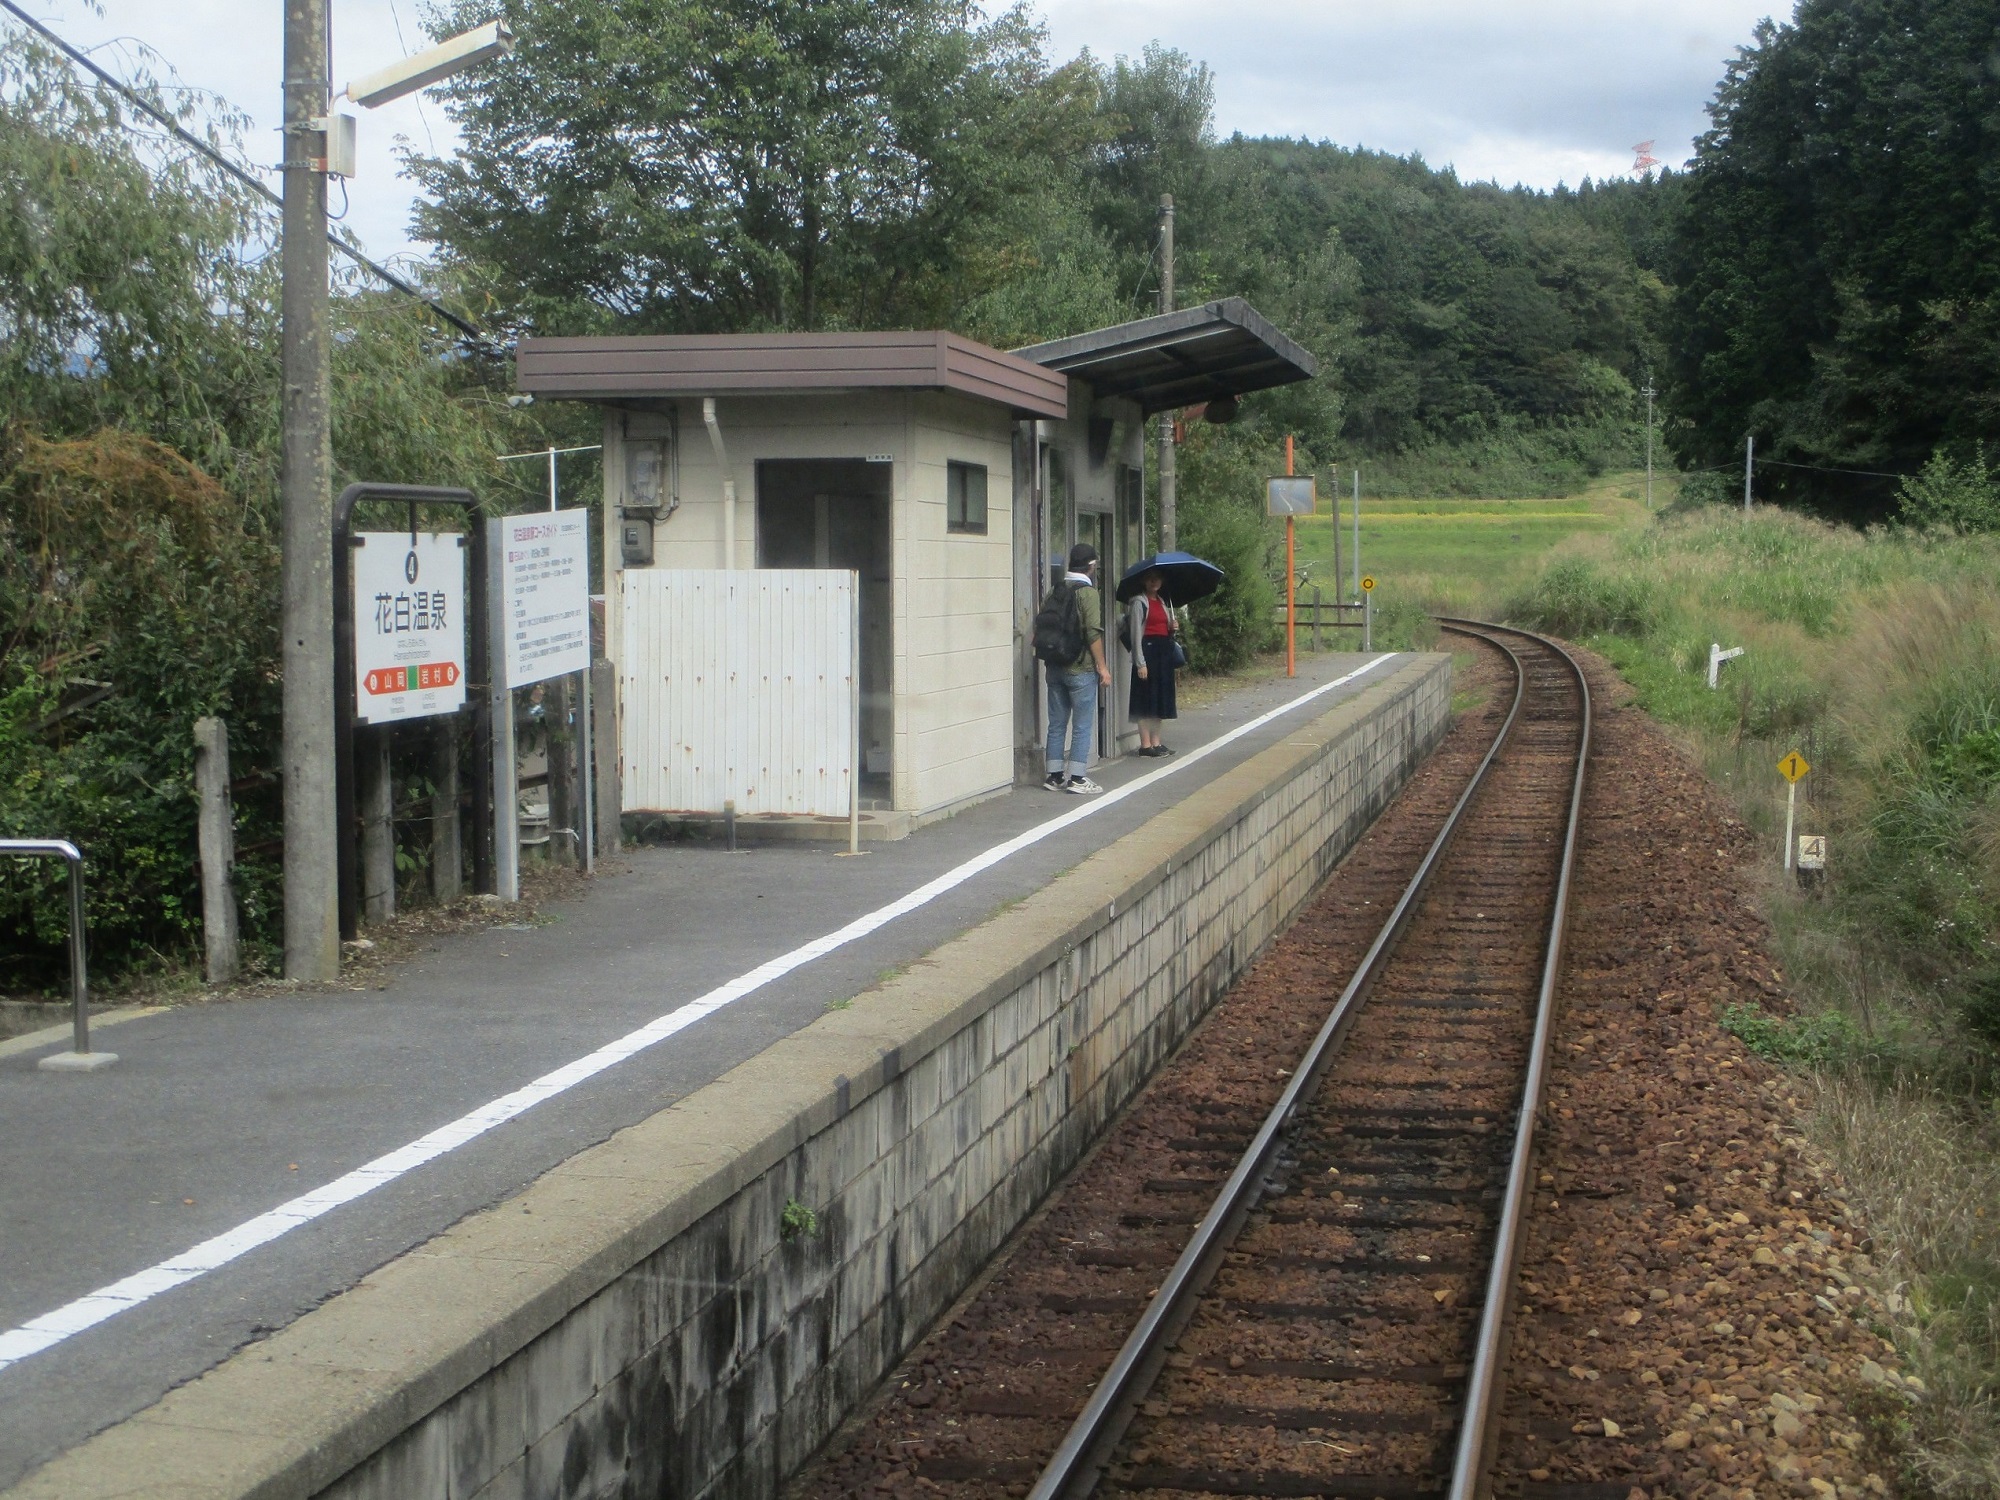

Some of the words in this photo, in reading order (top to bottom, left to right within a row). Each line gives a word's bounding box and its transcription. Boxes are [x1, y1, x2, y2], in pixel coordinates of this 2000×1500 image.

[408, 556, 415, 579] 4
[375, 590, 447, 635] 花白温泉
[384, 671, 405, 689] 山岡
[421, 667, 441, 685] 岩村
[1789, 758, 1797, 776] 1
[1805, 838, 1822, 858] 4
